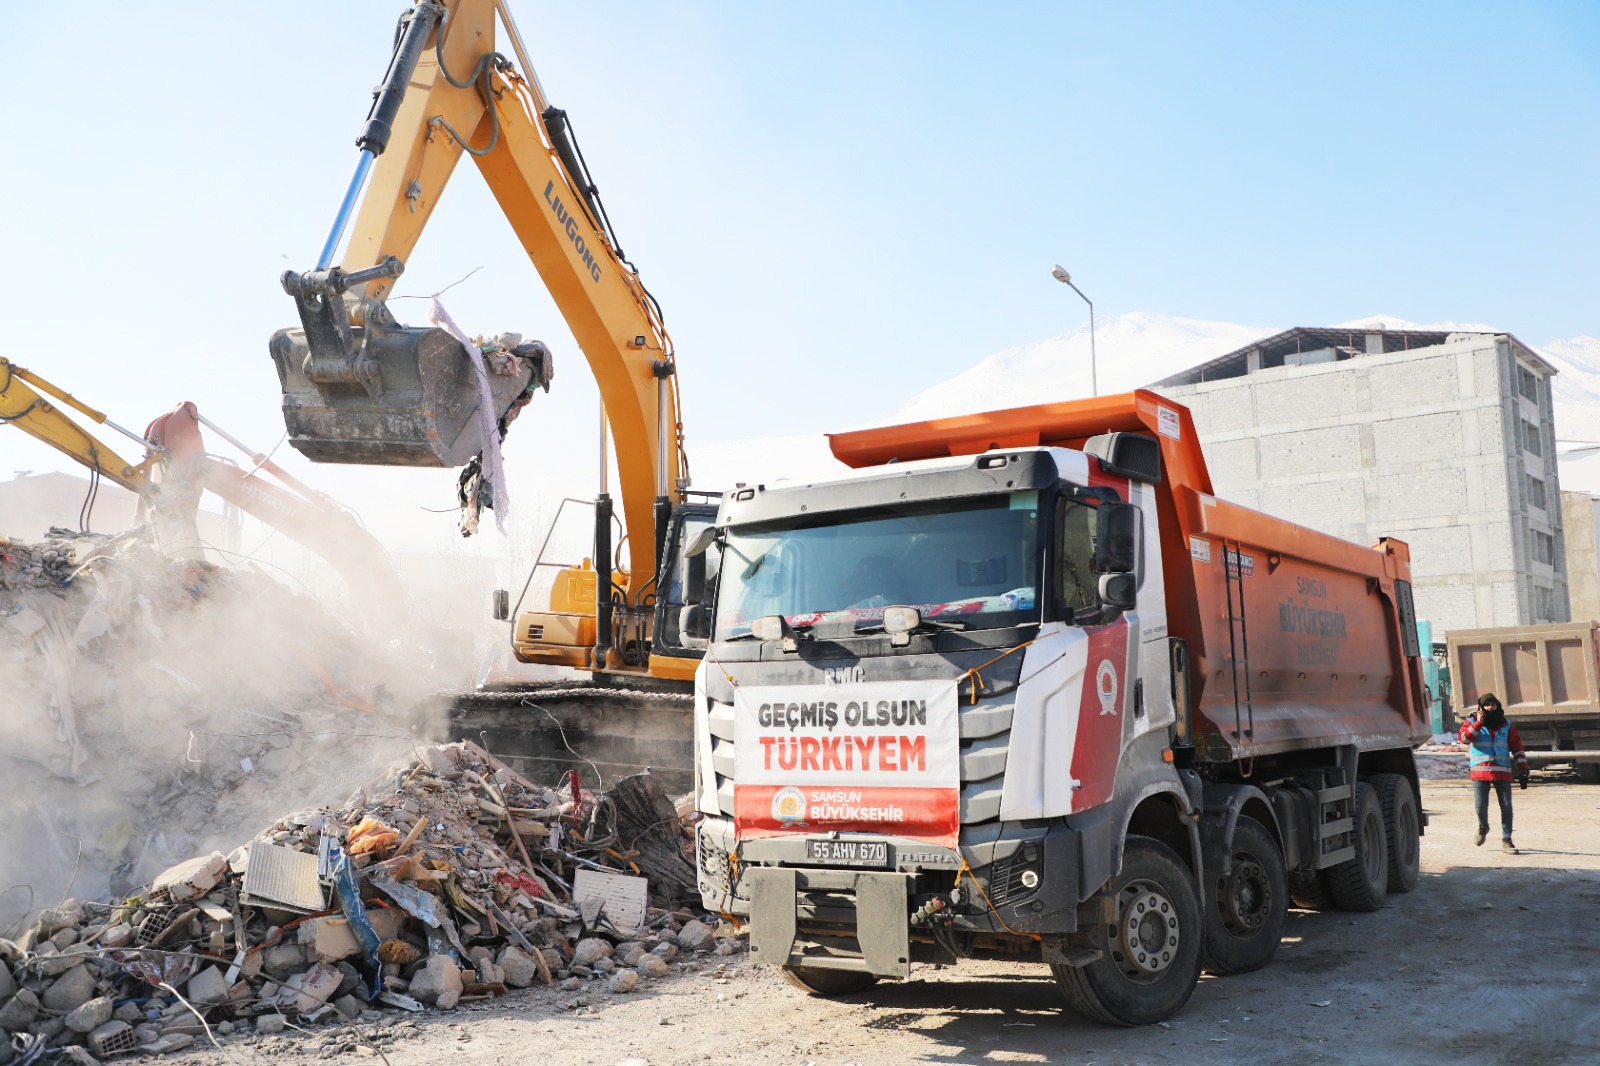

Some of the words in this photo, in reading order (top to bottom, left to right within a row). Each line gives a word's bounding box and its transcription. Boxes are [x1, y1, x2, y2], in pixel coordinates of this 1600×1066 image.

[543, 179, 602, 284] LIUGONG
[1296, 575, 1328, 600] SAMSUN
[844, 699, 927, 728] OLSUN
[759, 735, 926, 772] TÜRKİYEM
[811, 791, 862, 803] SAMSUN
[810, 803, 904, 822] BÜYÜKŞEHİR
[813, 841, 829, 858] 55
[832, 842, 857, 859] AHV
[860, 843, 885, 860] 670
